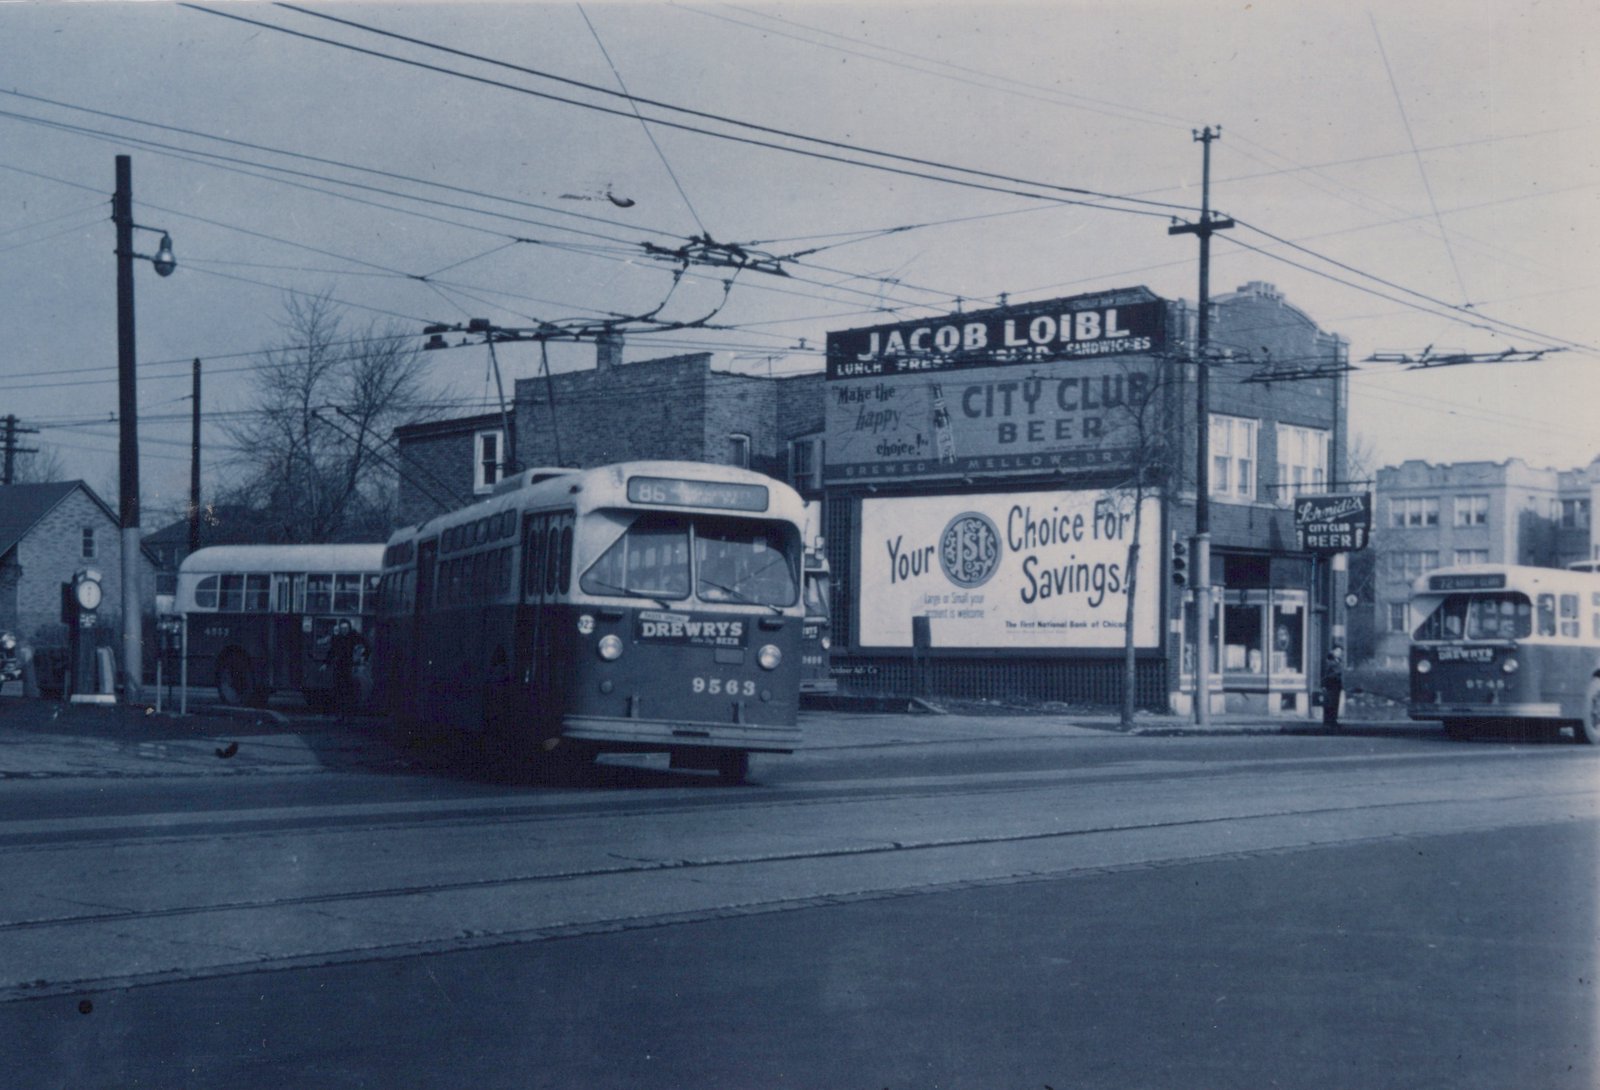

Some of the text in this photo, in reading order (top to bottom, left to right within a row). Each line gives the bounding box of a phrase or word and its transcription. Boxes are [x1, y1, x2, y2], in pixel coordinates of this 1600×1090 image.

[857, 322, 988, 362] JACOB
[1004, 309, 1131, 347] LOIBL
[962, 371, 1149, 418] CITY CLUB
[855, 404, 899, 434] happy
[998, 416, 1106, 444] BEER
[1007, 499, 1131, 552] Choice For
[1308, 522, 1351, 533] CITY CLUB
[1307, 534, 1352, 548] BEER
[887, 535, 935, 584] Your
[642, 621, 743, 637] DREWRYS
[1006, 620, 1017, 628] The
[1037, 620, 1067, 628] National
[1069, 620, 1088, 628] Bank
[692, 677, 756, 697] 9563
